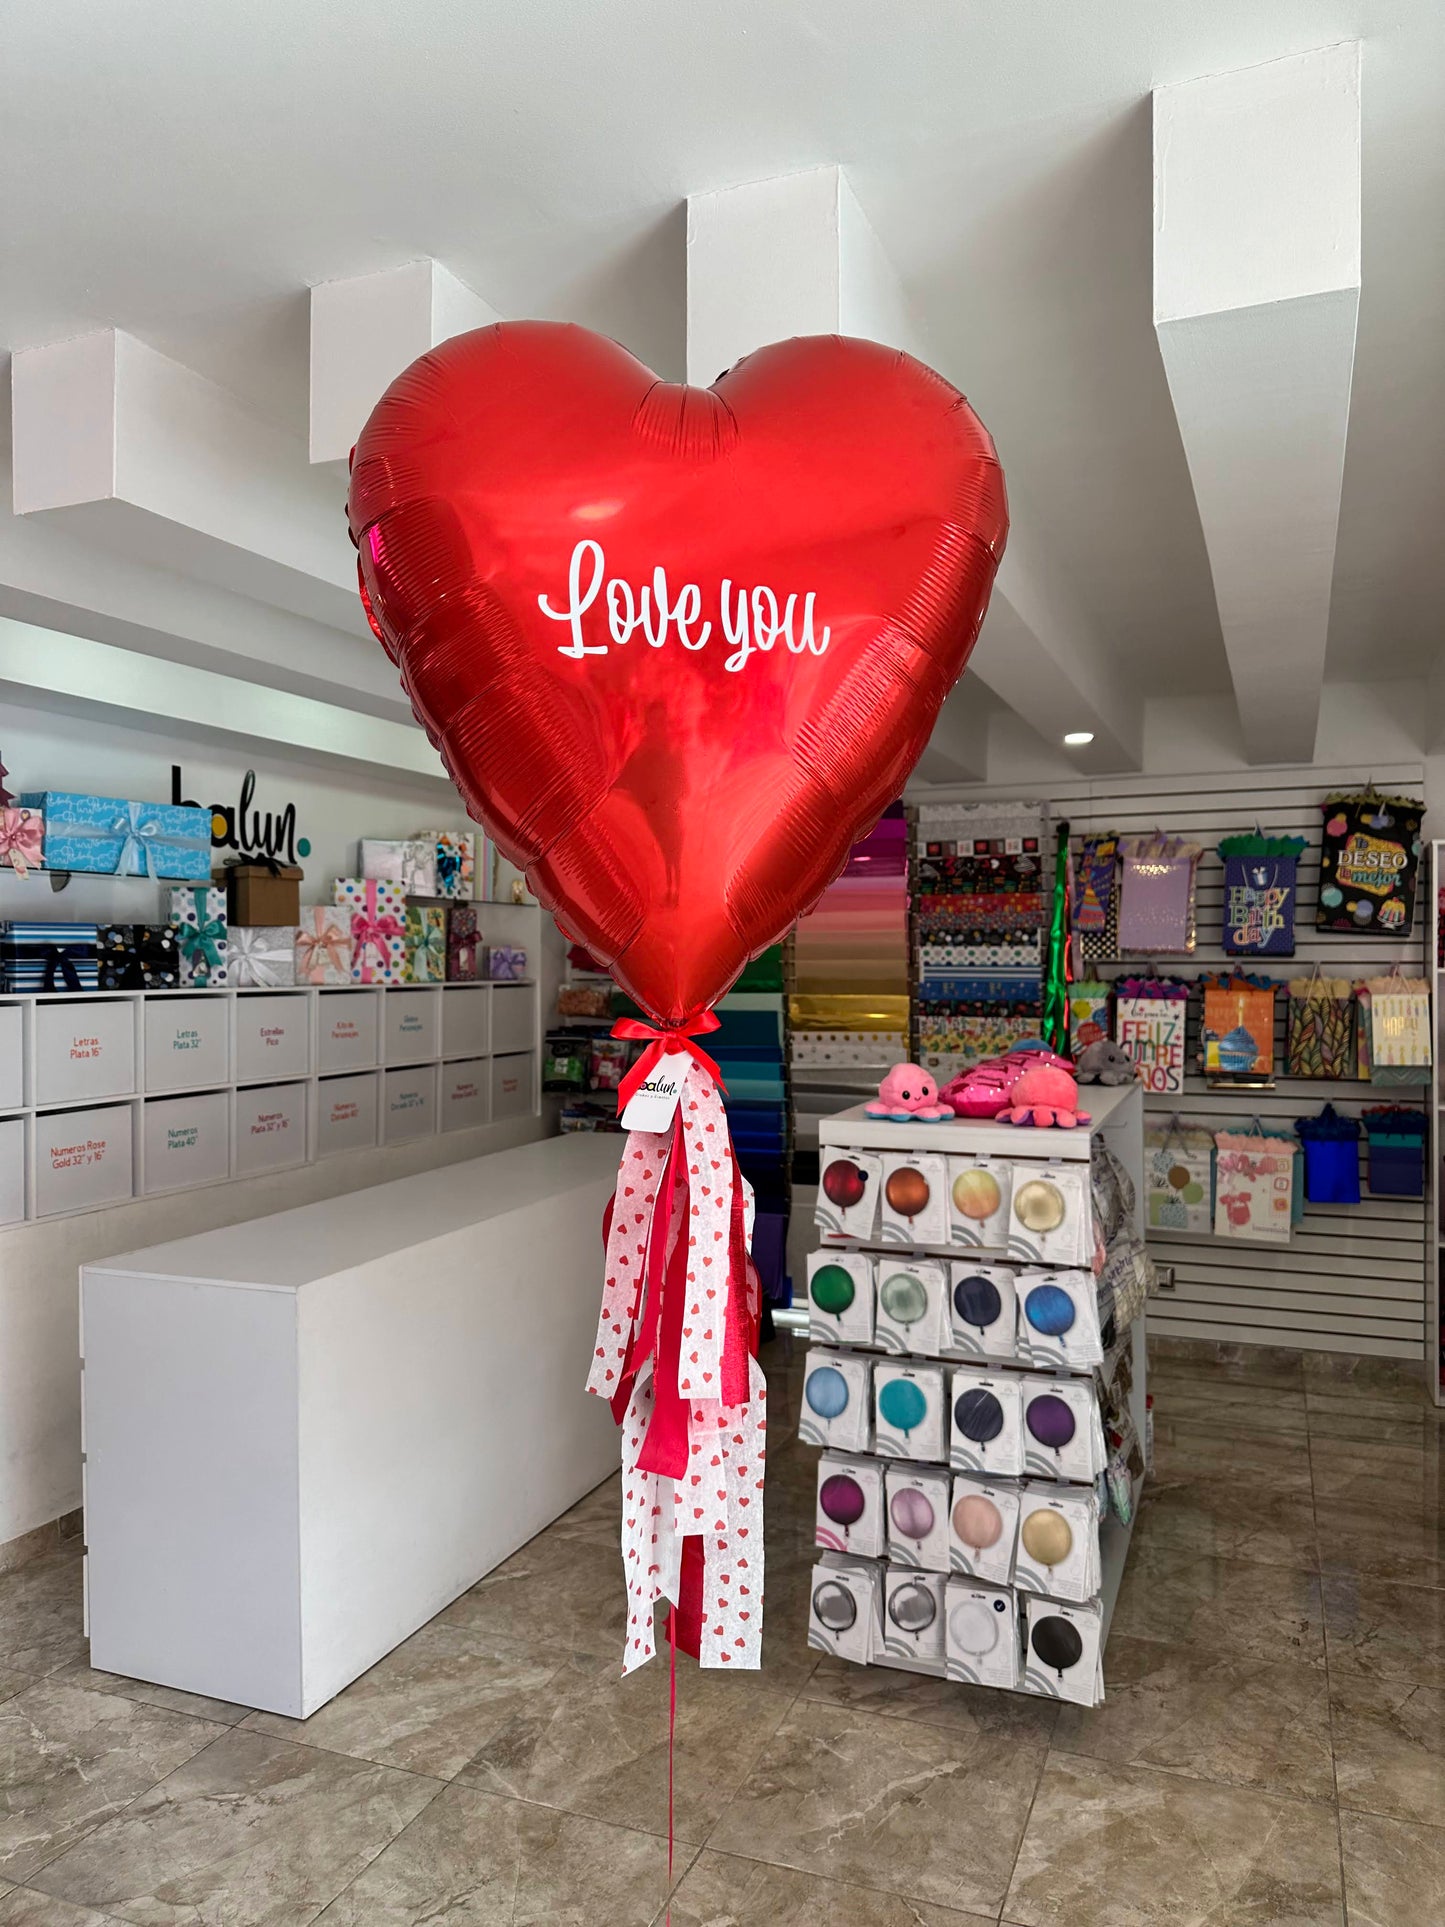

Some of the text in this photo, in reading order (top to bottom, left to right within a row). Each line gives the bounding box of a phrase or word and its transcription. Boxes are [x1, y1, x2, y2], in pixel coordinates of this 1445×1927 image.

[537, 539, 831, 672] Love you
[1337, 849, 1409, 869] DESEO
[1351, 867, 1402, 888] mejor
[1228, 904, 1285, 929] Birth
[1233, 922, 1275, 949] day
[177, 1029, 198, 1039] Letras
[260, 1027, 284, 1037] Estrellas
[1122, 1020, 1177, 1051] FELIZ
[73, 1037, 99, 1047] Letras
[173, 1040, 190, 1050] Plata
[70, 1047, 102, 1060] Plata 16"
[258, 1113, 283, 1123] Numeros
[168, 1127, 198, 1138] Numeros
[251, 1125, 266, 1135] Plata
[51, 1140, 106, 1157] Numeros Rose
[167, 1136, 198, 1150] Plata 40"
[52, 1150, 105, 1169] Gold 32" y 16"
